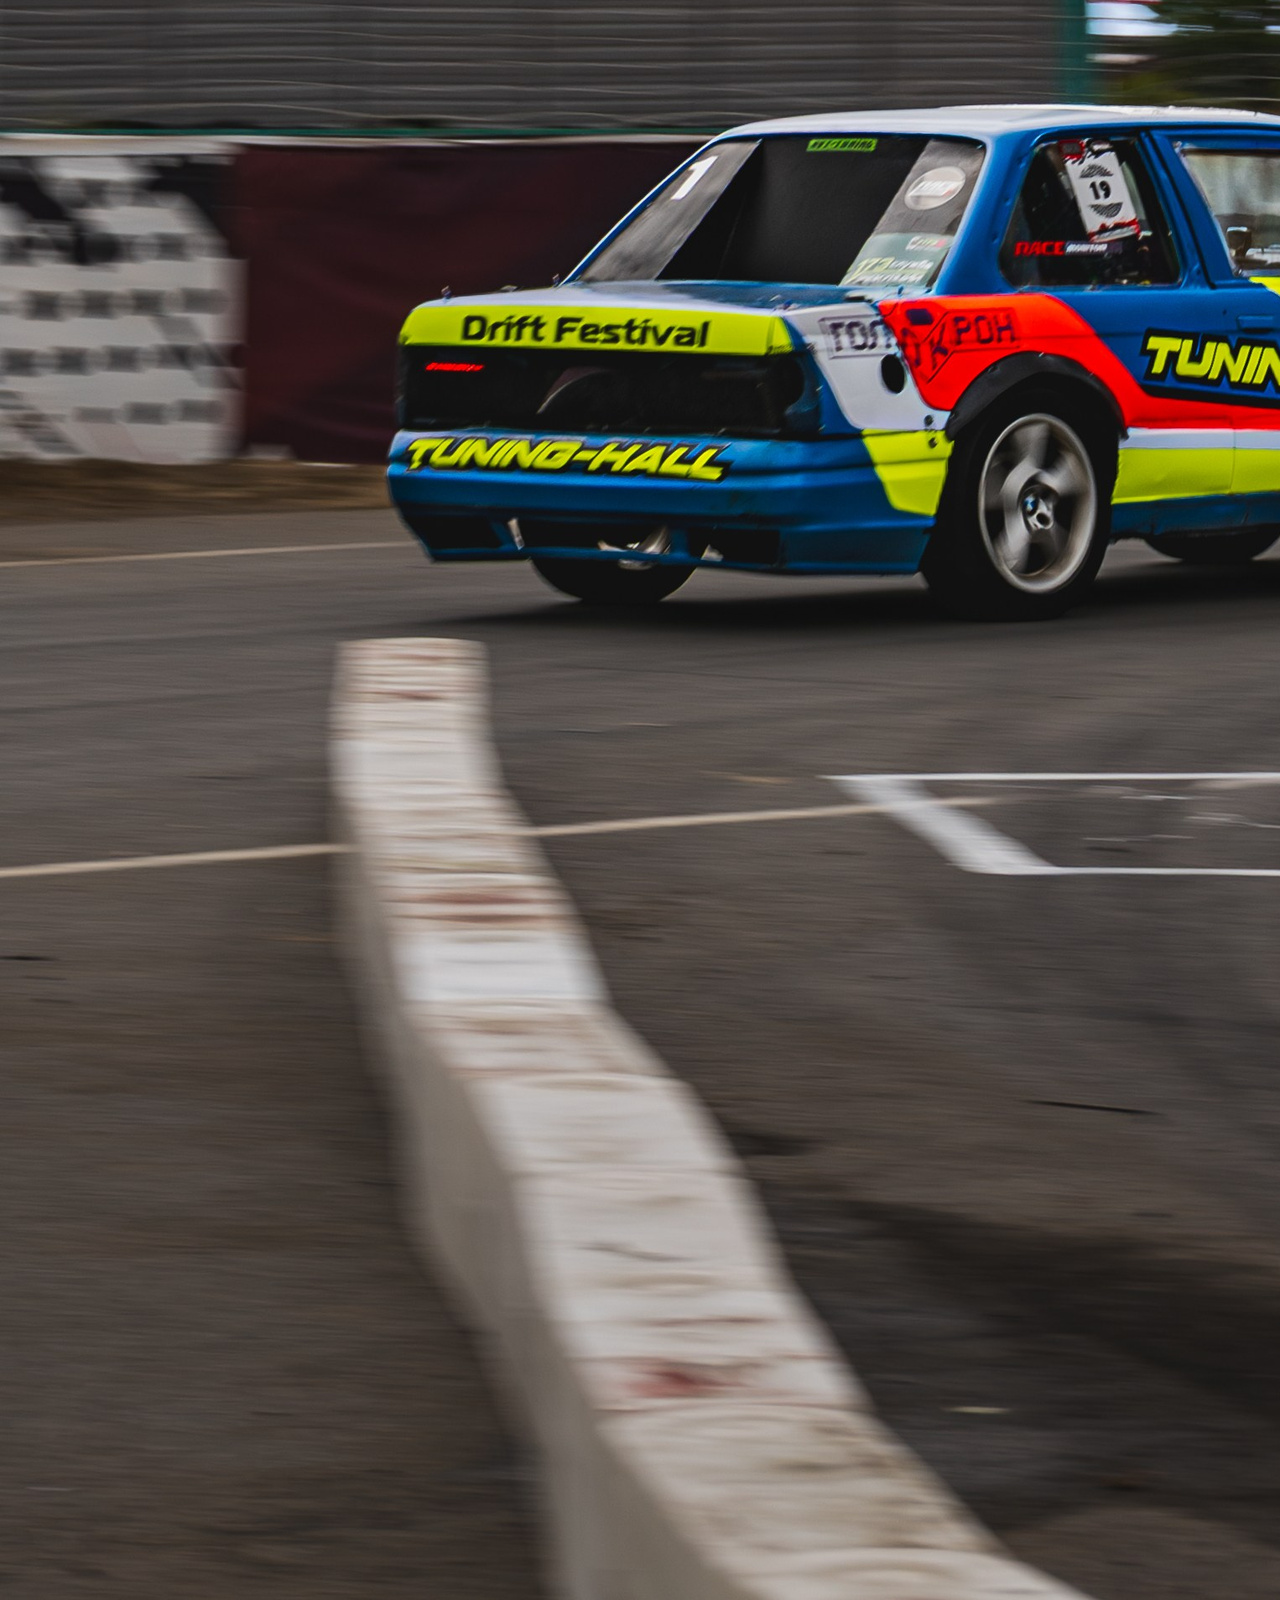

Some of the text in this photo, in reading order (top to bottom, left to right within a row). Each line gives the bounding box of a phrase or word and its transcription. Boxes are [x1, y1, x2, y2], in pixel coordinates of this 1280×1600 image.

[671, 155, 718, 200] 1
[1089, 180, 1112, 201] 19
[461, 314, 713, 348] Drift Festival
[404, 436, 726, 482] TUNING-HALL
